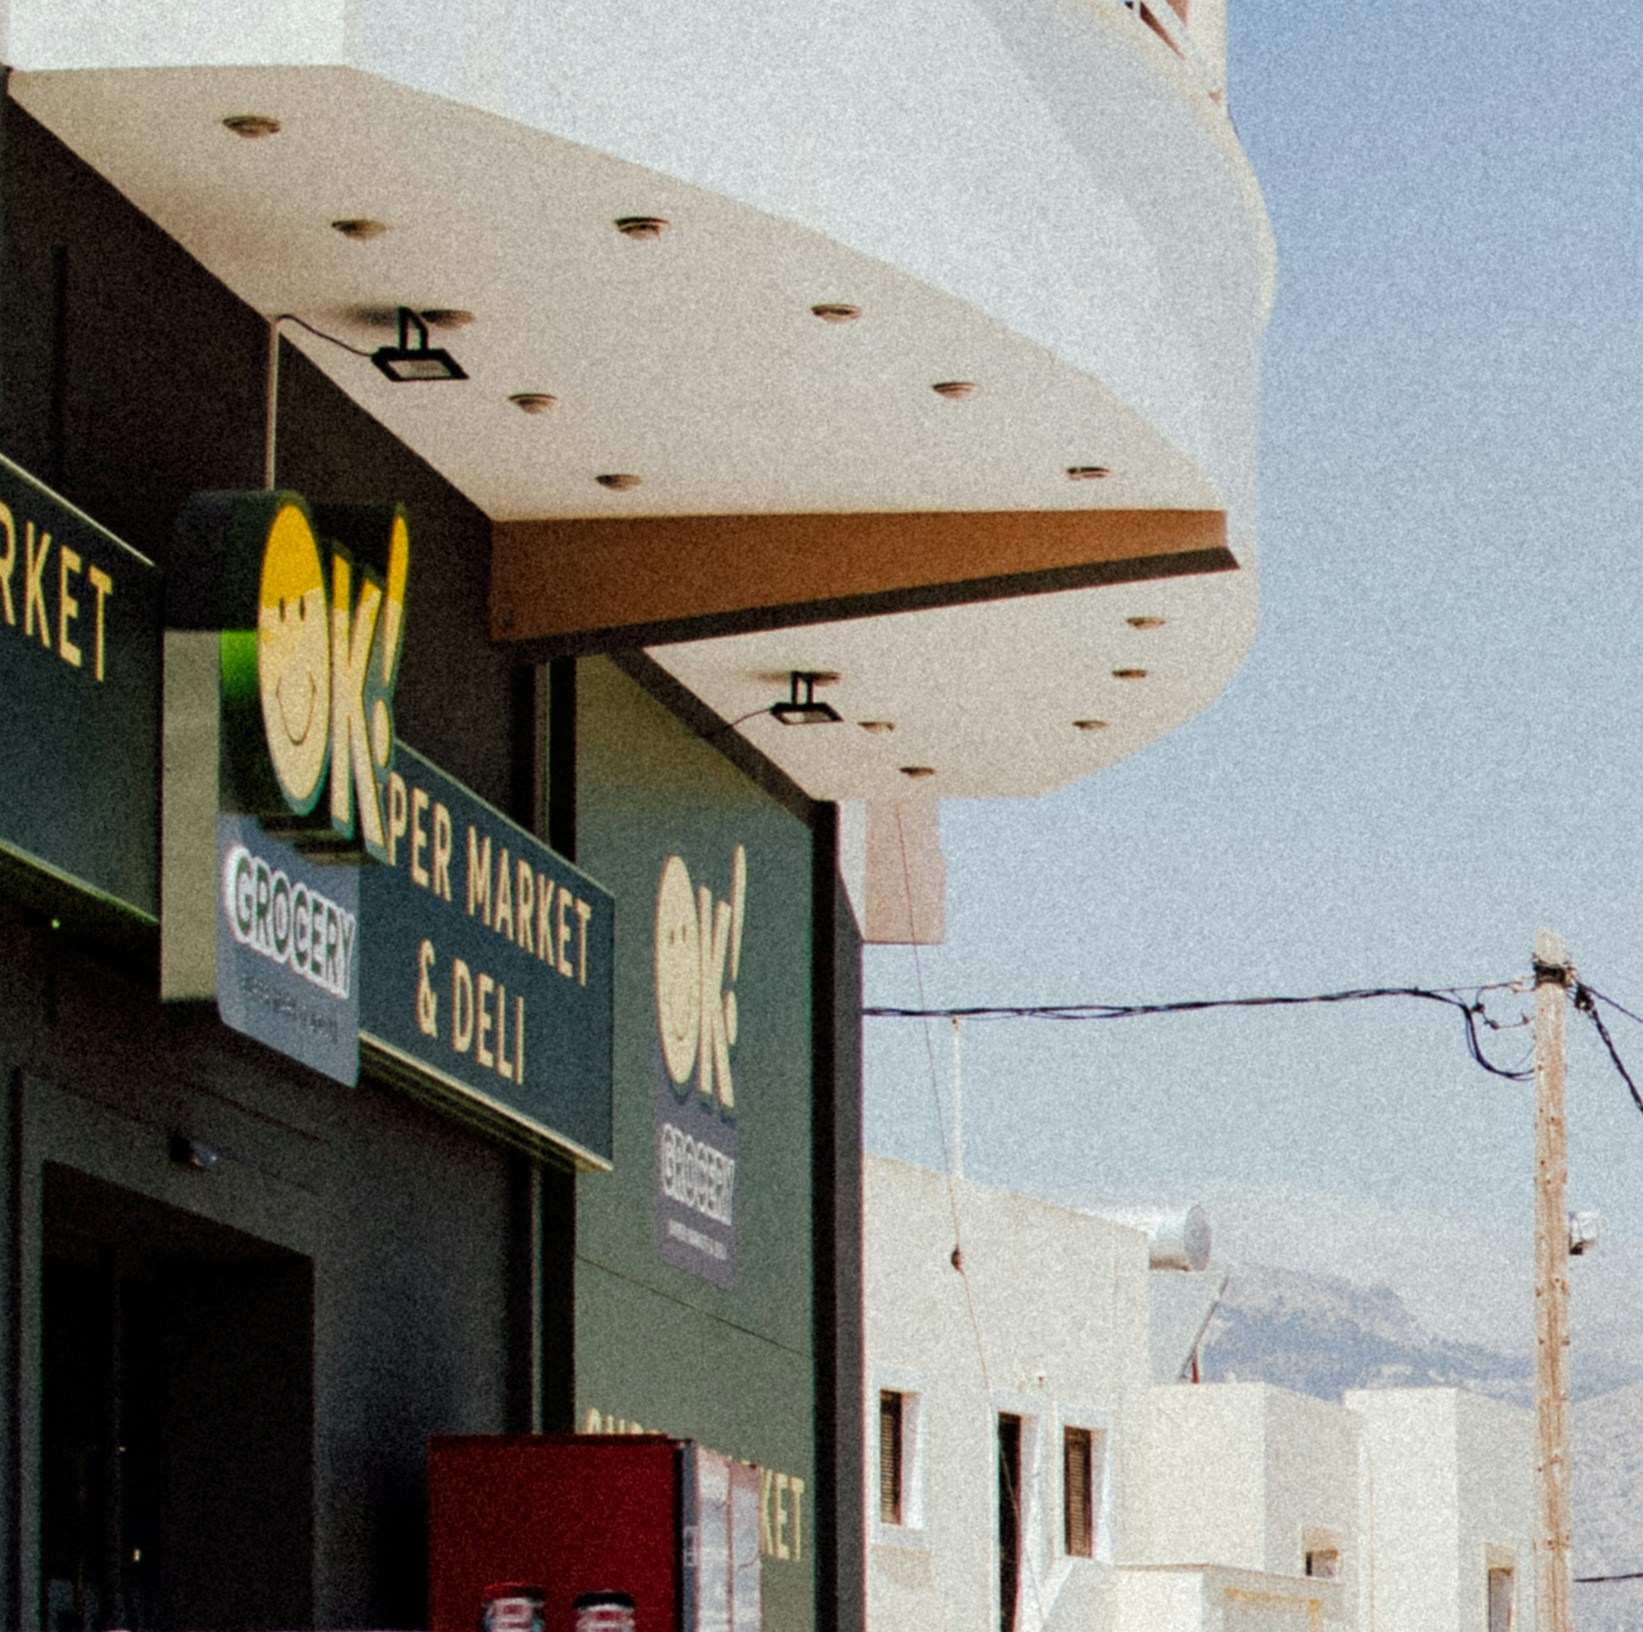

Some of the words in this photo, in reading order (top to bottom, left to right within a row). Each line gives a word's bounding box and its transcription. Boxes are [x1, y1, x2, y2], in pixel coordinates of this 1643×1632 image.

[225, 846, 356, 999] GROCERY
[386, 770, 452, 902] PER
[465, 825, 592, 987] MARKET
[416, 938, 438, 1038] &
[452, 957, 525, 1085] DELI
[661, 1122, 736, 1227] GROCERY
